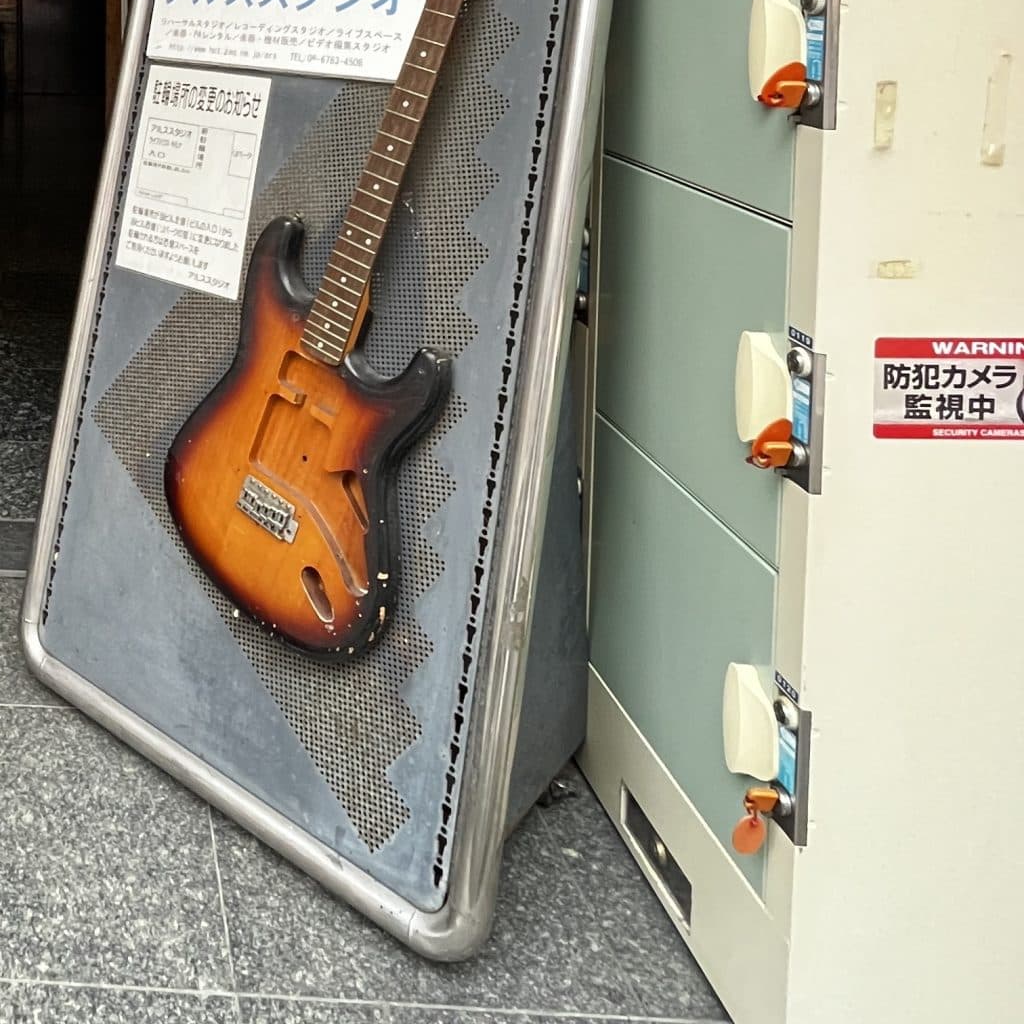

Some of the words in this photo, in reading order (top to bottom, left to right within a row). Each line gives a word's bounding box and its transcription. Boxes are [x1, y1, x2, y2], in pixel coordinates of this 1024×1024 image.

[883, 363, 1017, 390] 防犯カメラ
[904, 394, 995, 421] 監視中
[932, 428, 978, 437] SECURITY
